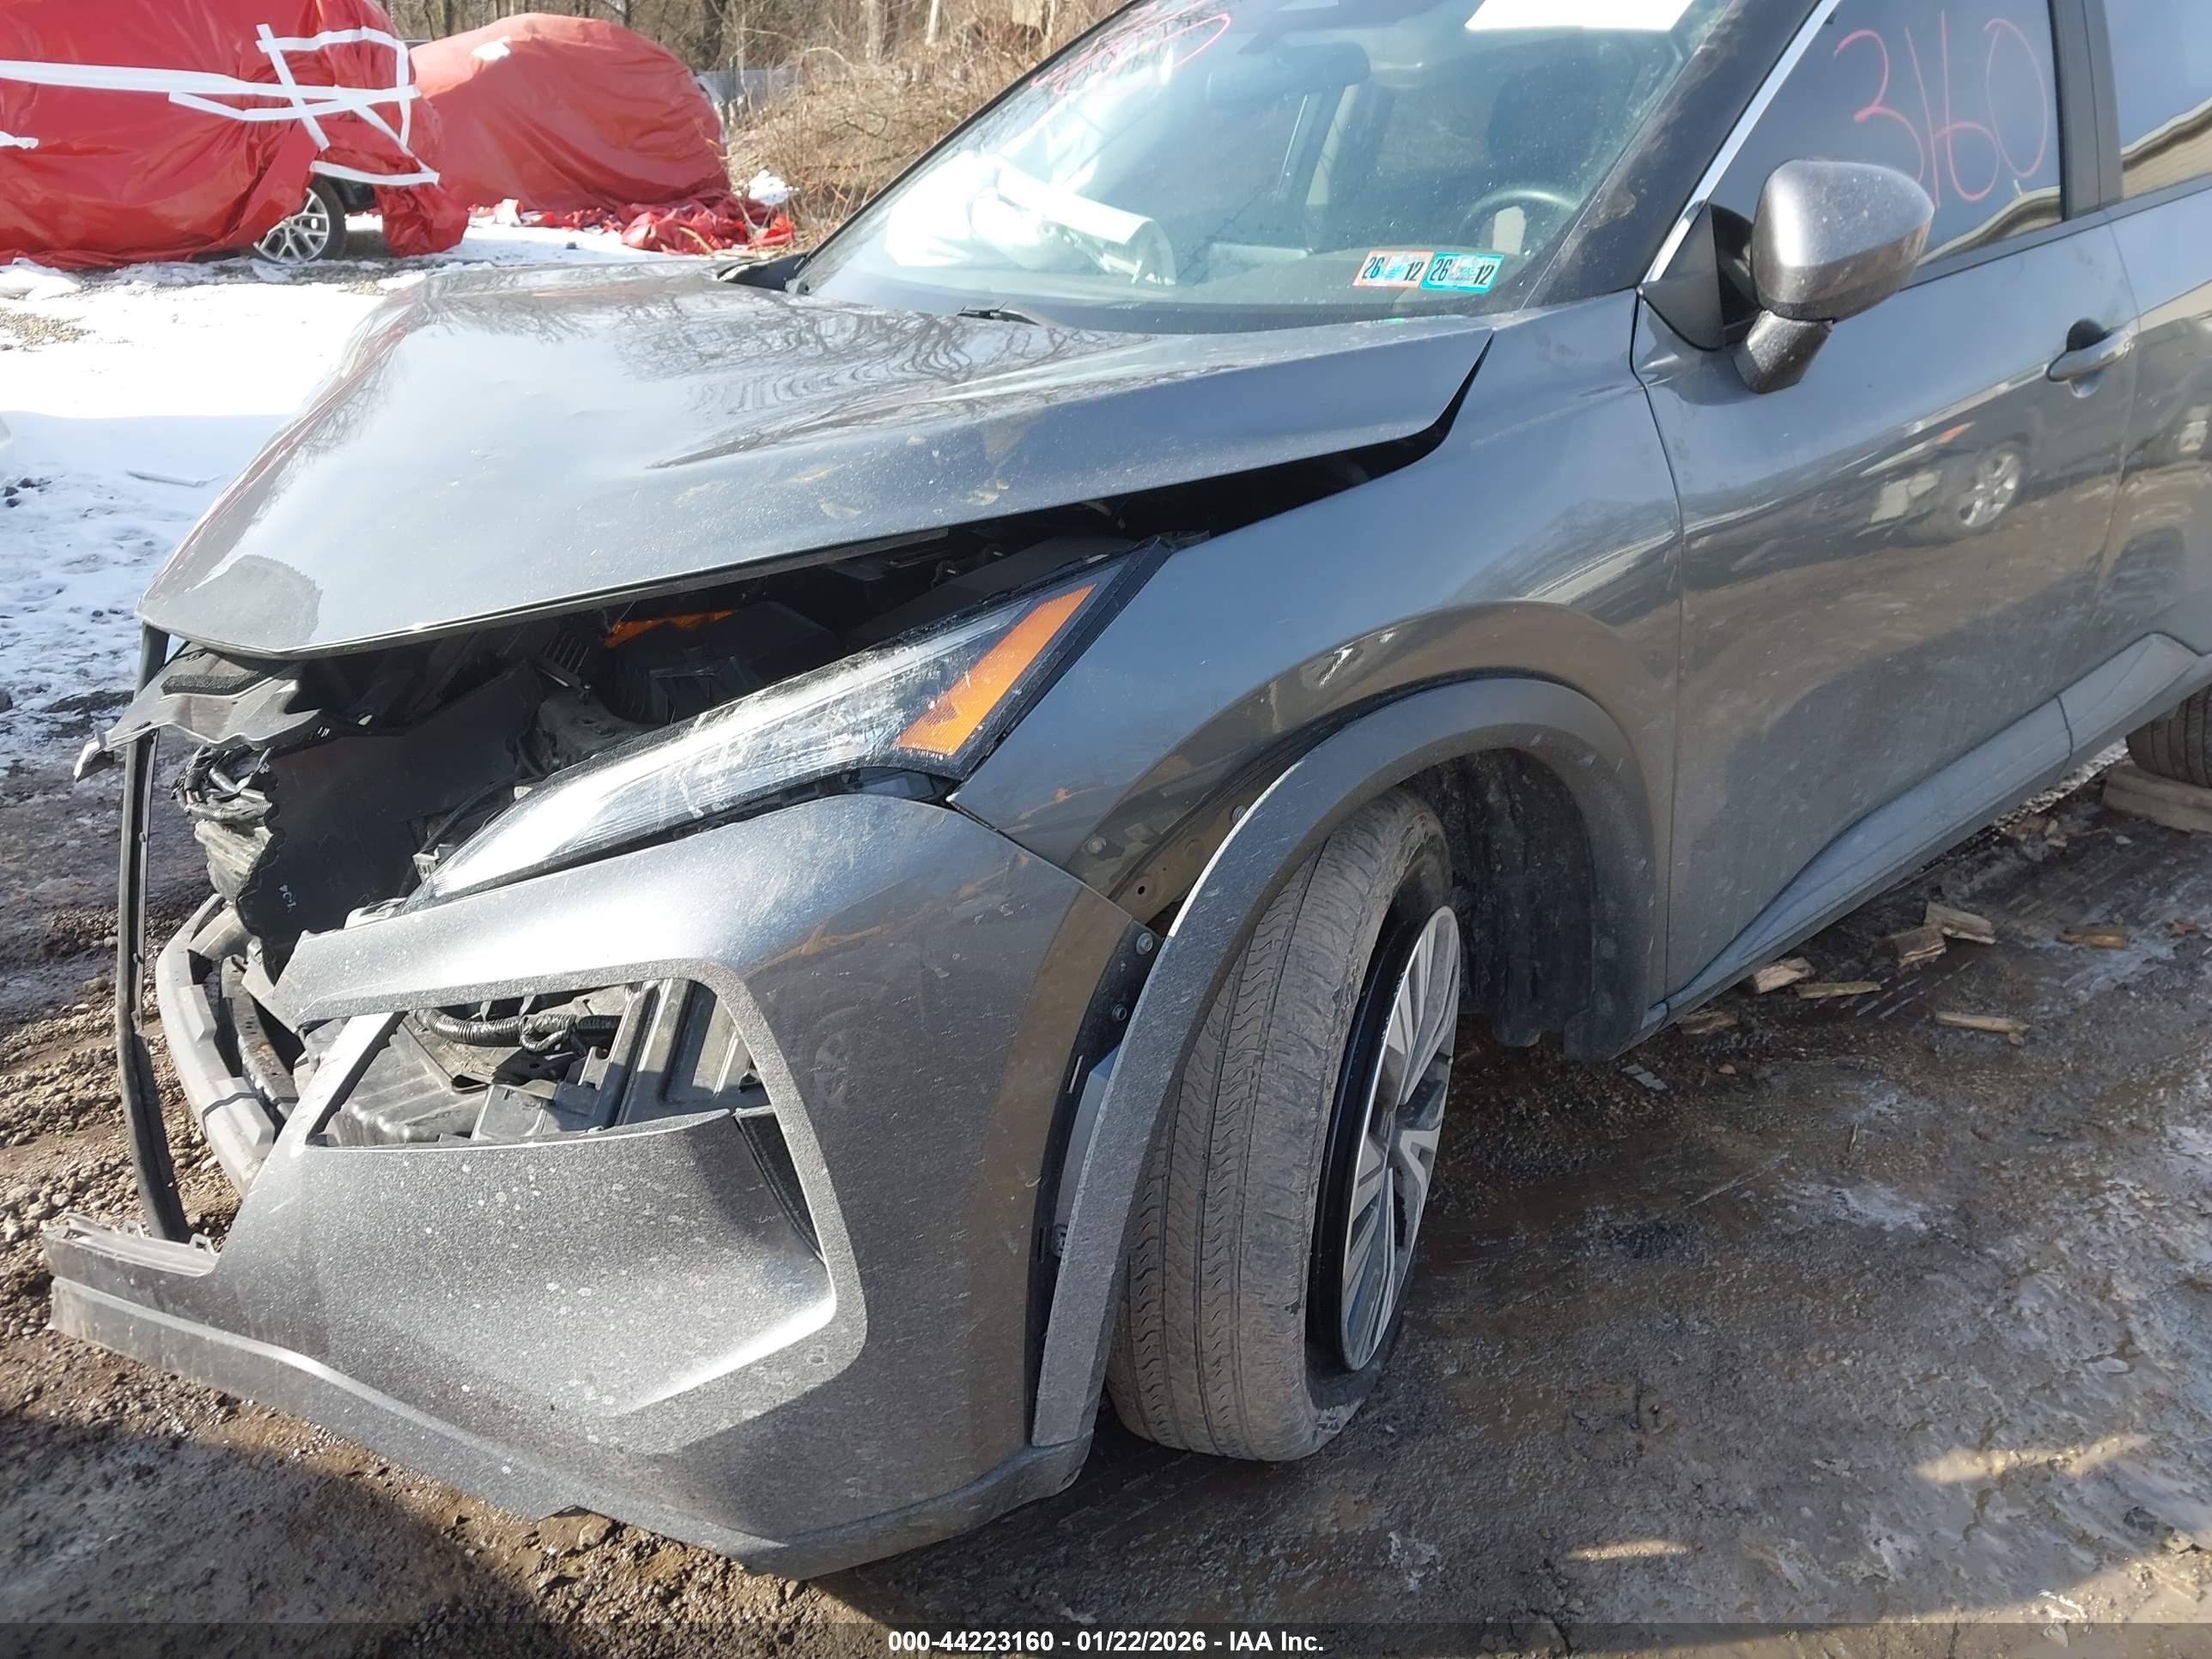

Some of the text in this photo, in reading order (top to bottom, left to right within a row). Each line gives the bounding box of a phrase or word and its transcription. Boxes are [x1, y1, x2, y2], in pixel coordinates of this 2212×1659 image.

[1833, 9, 2048, 209] 3160
[1361, 256, 1385, 280] 26
[1403, 260, 1425, 282] 12
[1429, 258, 1454, 282] 26
[1473, 264, 1496, 286] 12
